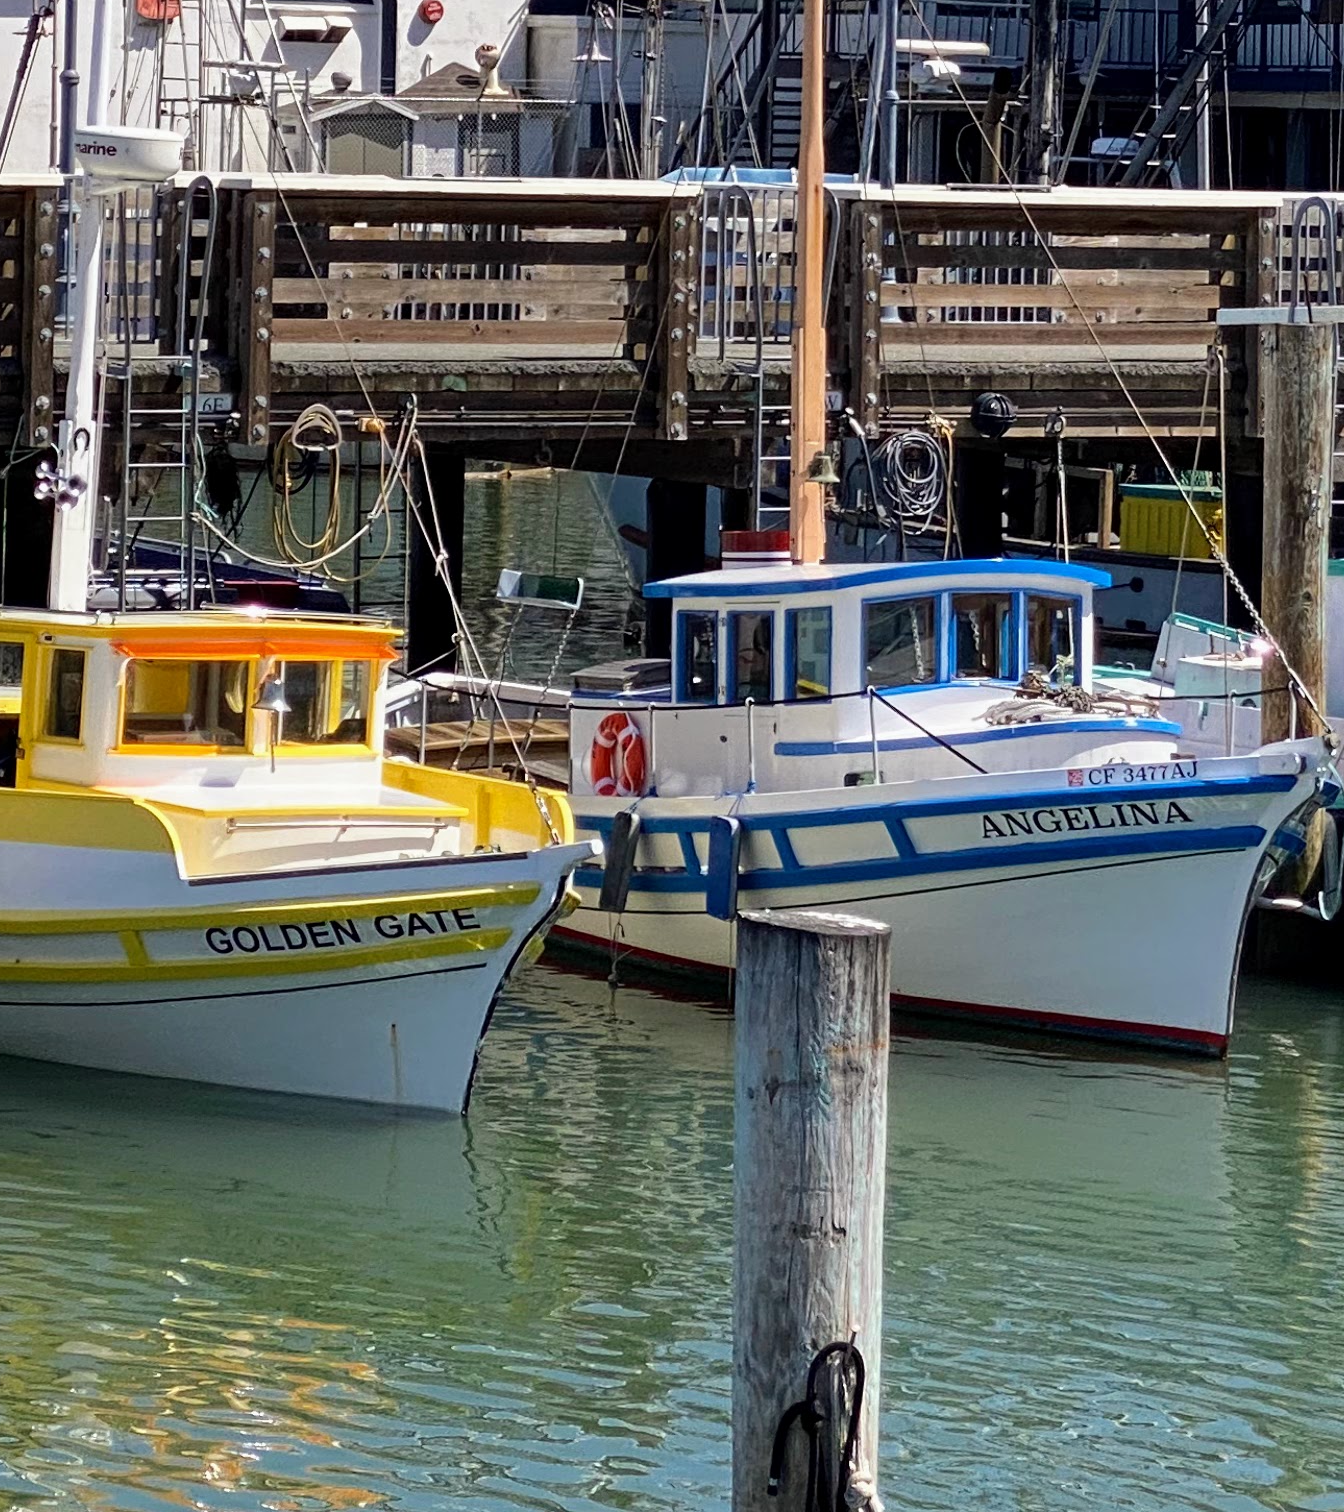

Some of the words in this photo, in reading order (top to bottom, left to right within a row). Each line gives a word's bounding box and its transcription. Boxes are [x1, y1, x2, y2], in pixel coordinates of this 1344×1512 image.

[1088, 767, 1116, 786] CF
[981, 801, 1194, 839] ANGELINA
[205, 918, 362, 955] GOLDEN
[373, 907, 482, 940] GATE
